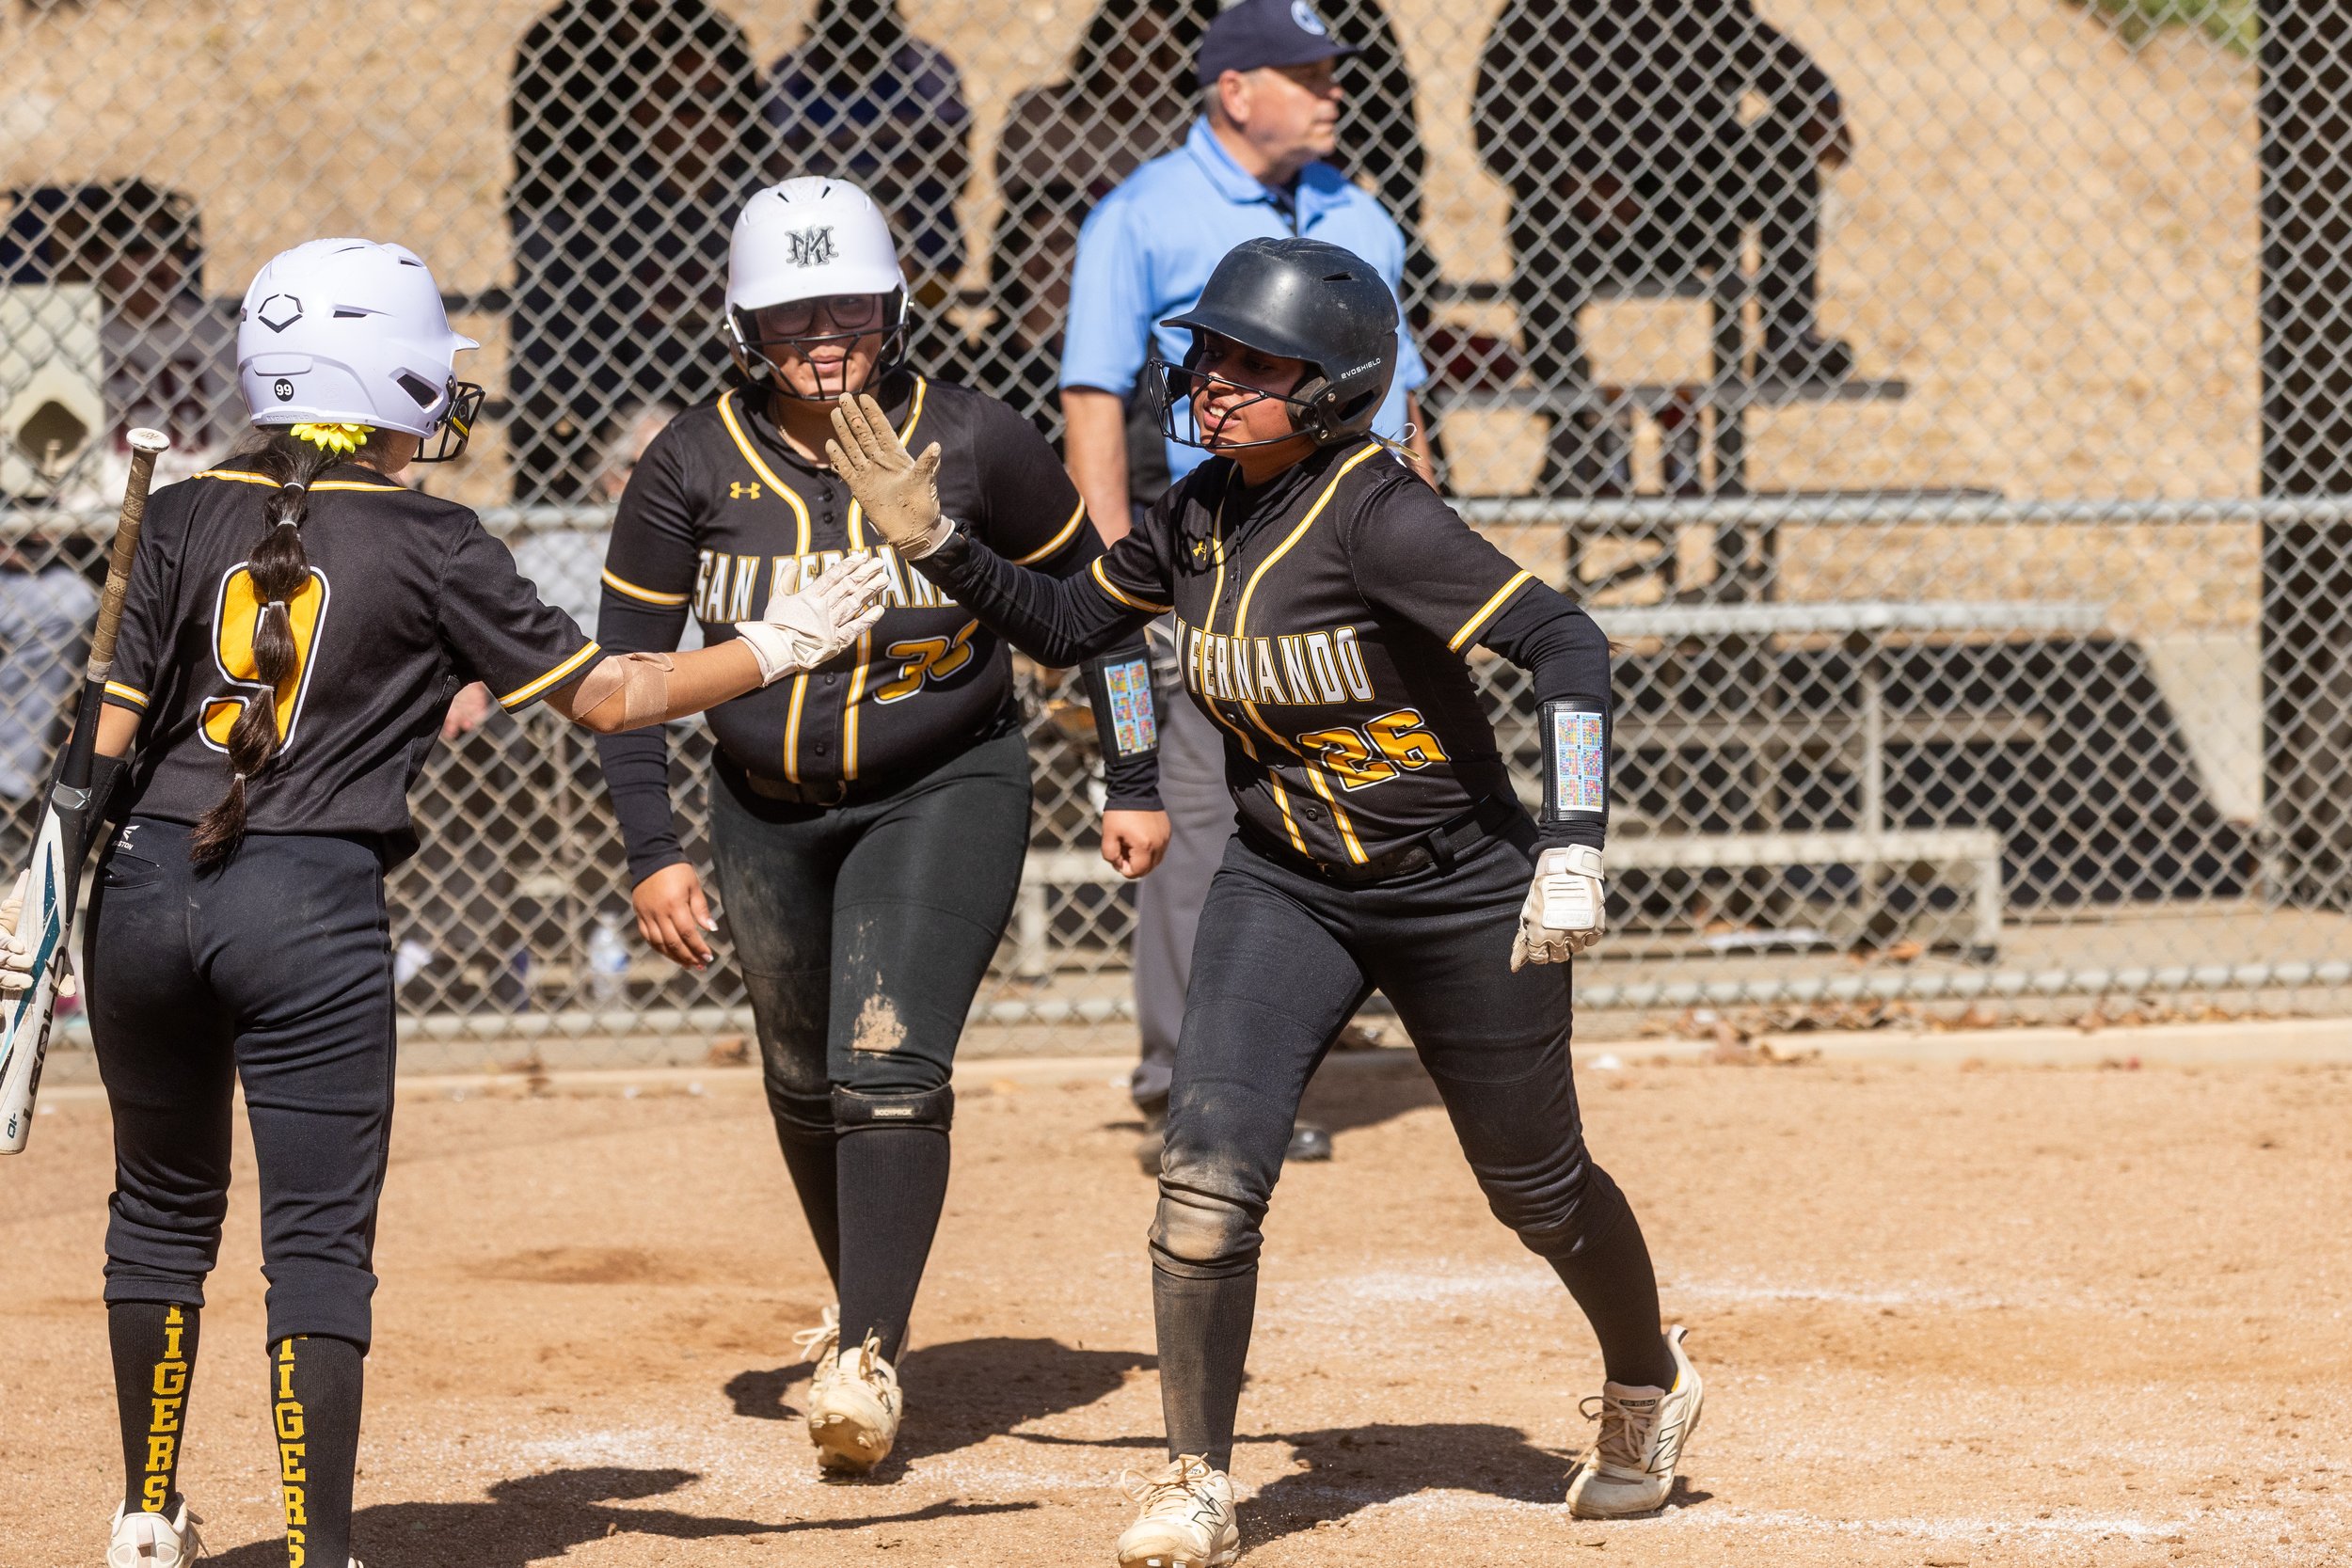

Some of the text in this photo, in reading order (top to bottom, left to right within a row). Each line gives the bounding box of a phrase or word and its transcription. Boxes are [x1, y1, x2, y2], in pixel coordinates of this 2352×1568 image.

[275, 384, 294, 396] 99
[692, 548, 760, 624] SAN
[197, 561, 330, 760] 9
[1186, 625, 1375, 705] FERNANDO
[1295, 707, 1452, 792] 26
